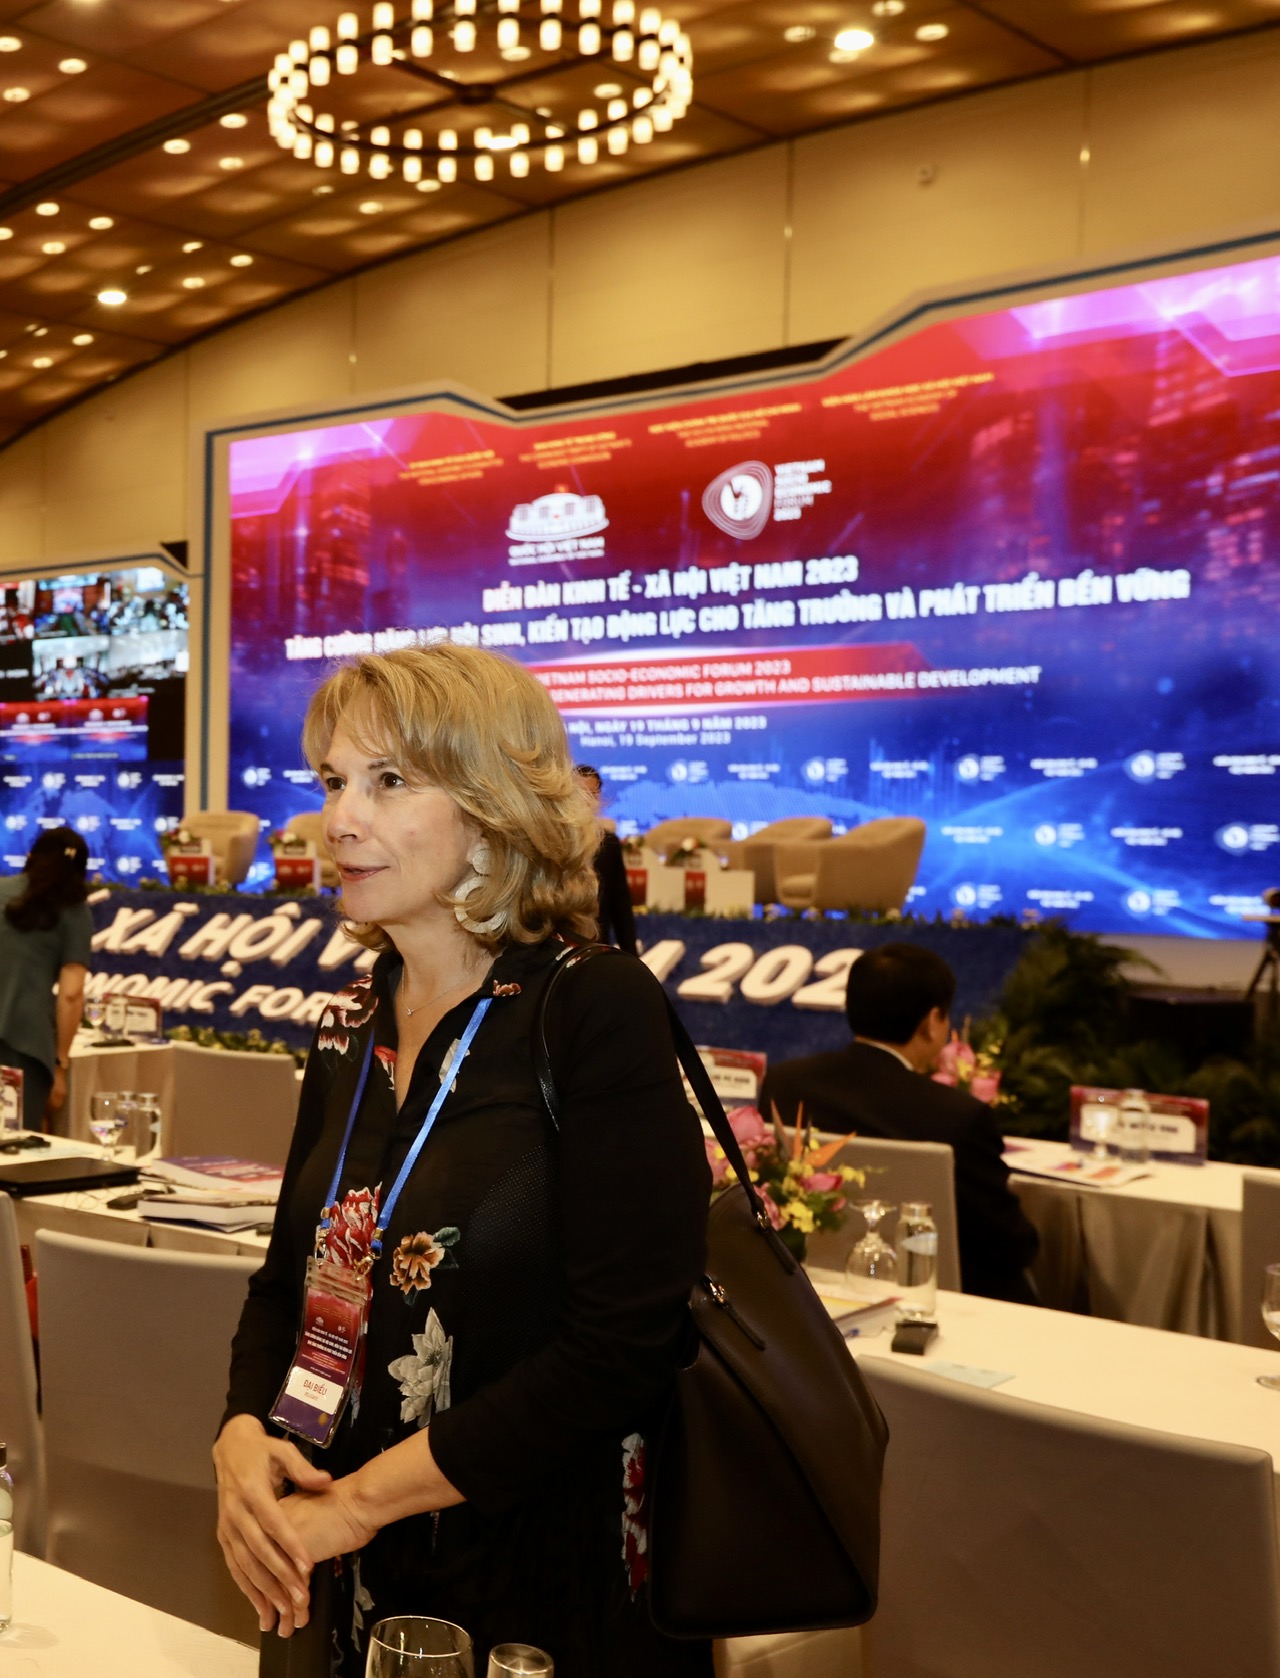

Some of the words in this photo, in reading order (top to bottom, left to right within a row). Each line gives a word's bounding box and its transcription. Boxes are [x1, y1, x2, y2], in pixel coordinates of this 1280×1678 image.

[562, 578, 606, 605] KINH
[607, 569, 631, 601] TẾ
[673, 566, 707, 599] HỘI
[709, 561, 752, 596] VIỆT
[754, 560, 803, 589] NAM
[805, 554, 859, 585] 2023
[527, 612, 568, 644] KIẾN
[570, 615, 604, 645] TẠO
[659, 606, 696, 639] LỰC
[698, 604, 739, 633] CHO
[741, 597, 795, 629] TĂNG
[885, 585, 916, 620] VÀ
[918, 581, 981, 618] PHÁT
[587, 665, 701, 685] SOCIO-ECONOMIC
[702, 661, 753, 679] FORUM
[754, 659, 792, 677] 2023
[627, 683, 684, 700] DRIVERS
[685, 681, 713, 697] FOR
[714, 678, 776, 696] GROWTH
[777, 677, 810, 694] AND
[811, 671, 916, 693] SUSTAINABLE
[917, 665, 1042, 689] DEVELOPMENT
[580, 733, 617, 748] Hanoi,
[618, 733, 634, 747] 19
[635, 732, 697, 748] September
[699, 731, 731, 745] 2023
[629, 719, 646, 733] 19
[646, 717, 690, 732] THÁNG
[691, 718, 701, 731] 9
[734, 716, 767, 730] 2023
[91, 901, 200, 957] XÃ
[178, 902, 322, 978] HỘI
[52, 971, 235, 1014] NOMIC
[229, 984, 334, 1028] FOR
[677, 942, 864, 1011] 202
